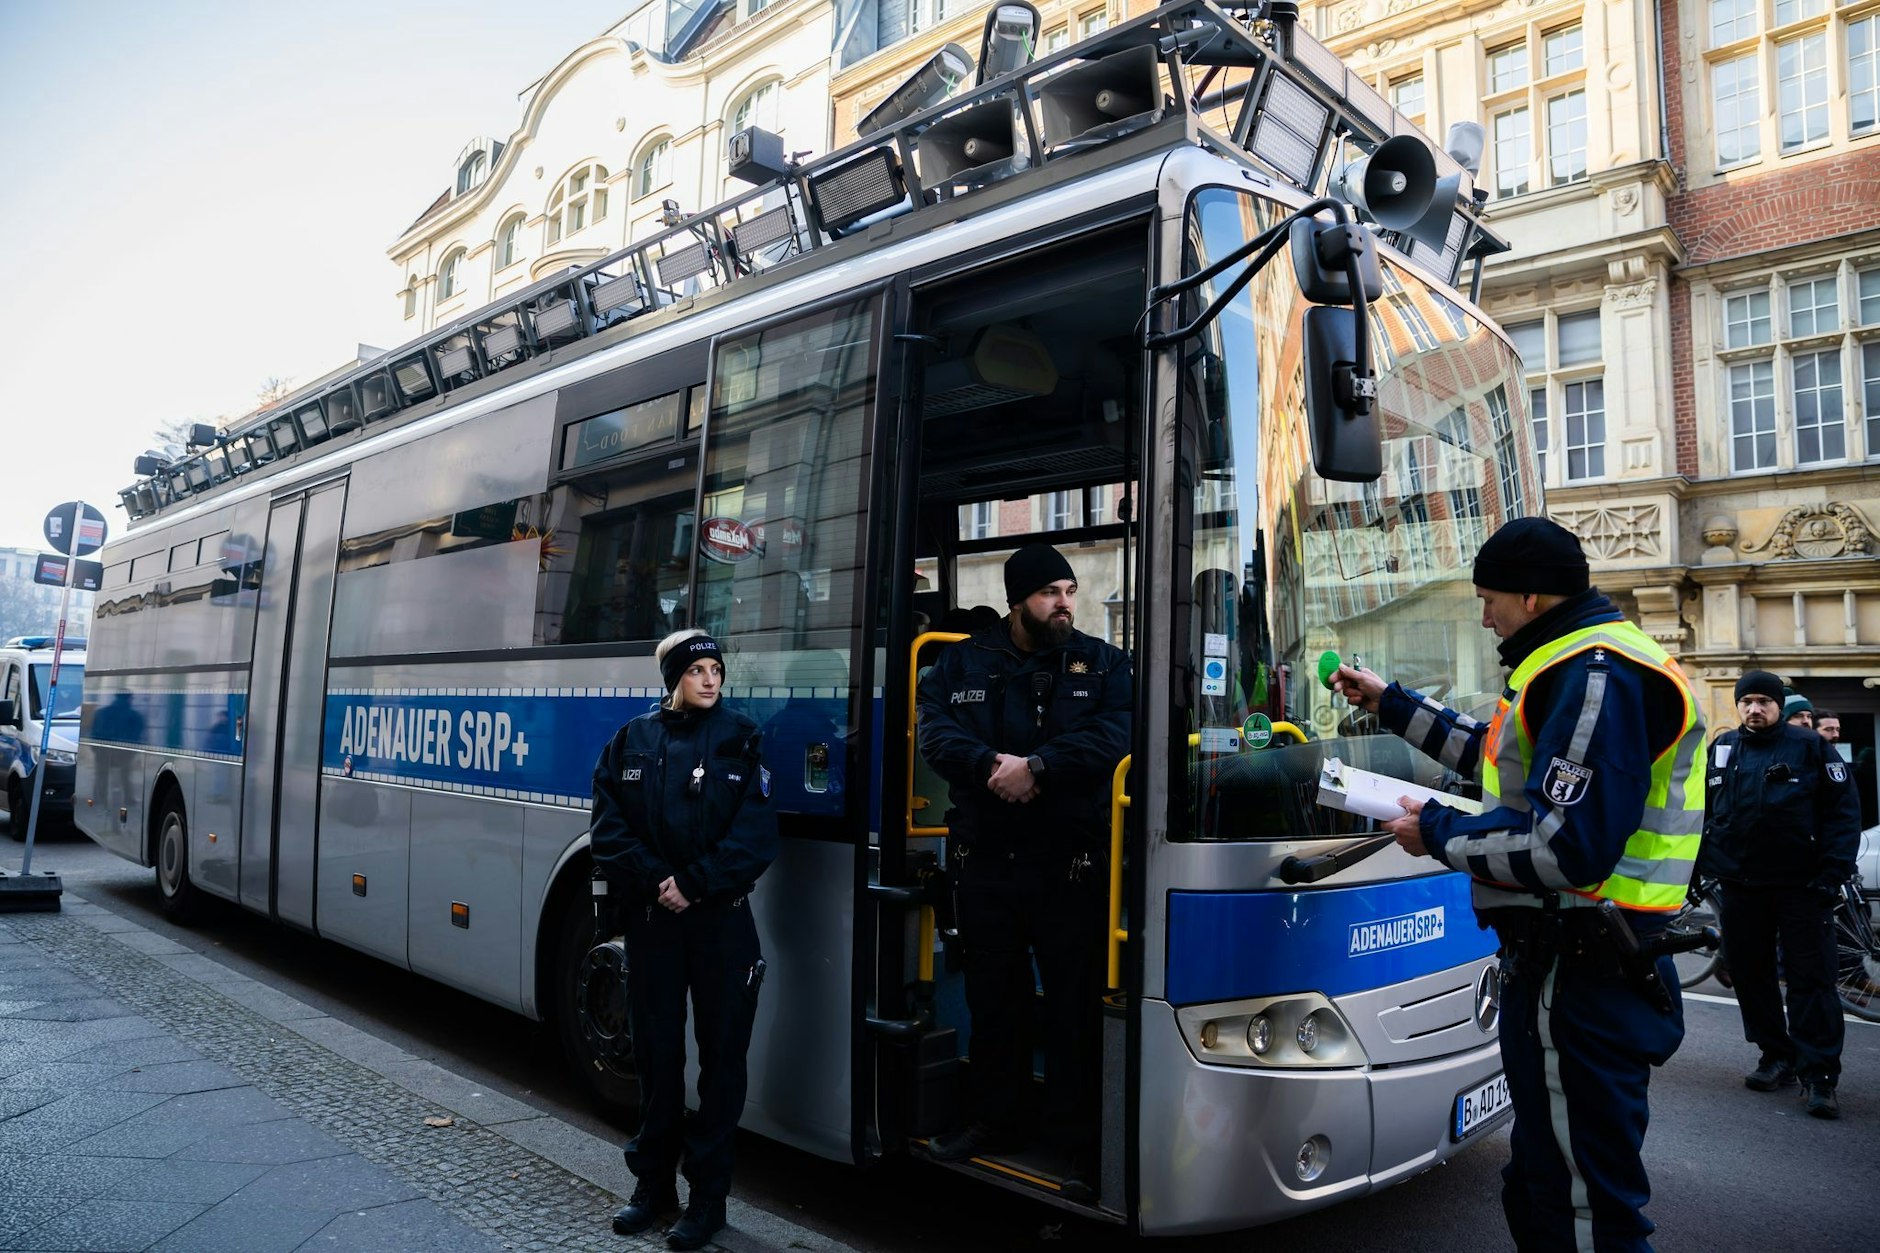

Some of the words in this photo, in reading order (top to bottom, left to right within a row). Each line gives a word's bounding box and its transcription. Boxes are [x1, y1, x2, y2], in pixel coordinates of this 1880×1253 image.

[951, 690, 985, 704] POLIZEI
[1254, 716, 1262, 730] 4
[339, 705, 452, 766] ADENAUER
[458, 710, 529, 772] SRP+
[1553, 760, 1589, 779] POLIZEI
[1350, 918, 1415, 953] ADENAUER
[1417, 914, 1443, 939] SRP+
[1464, 1097, 1472, 1126] B
[1479, 1085, 1495, 1118] AD
